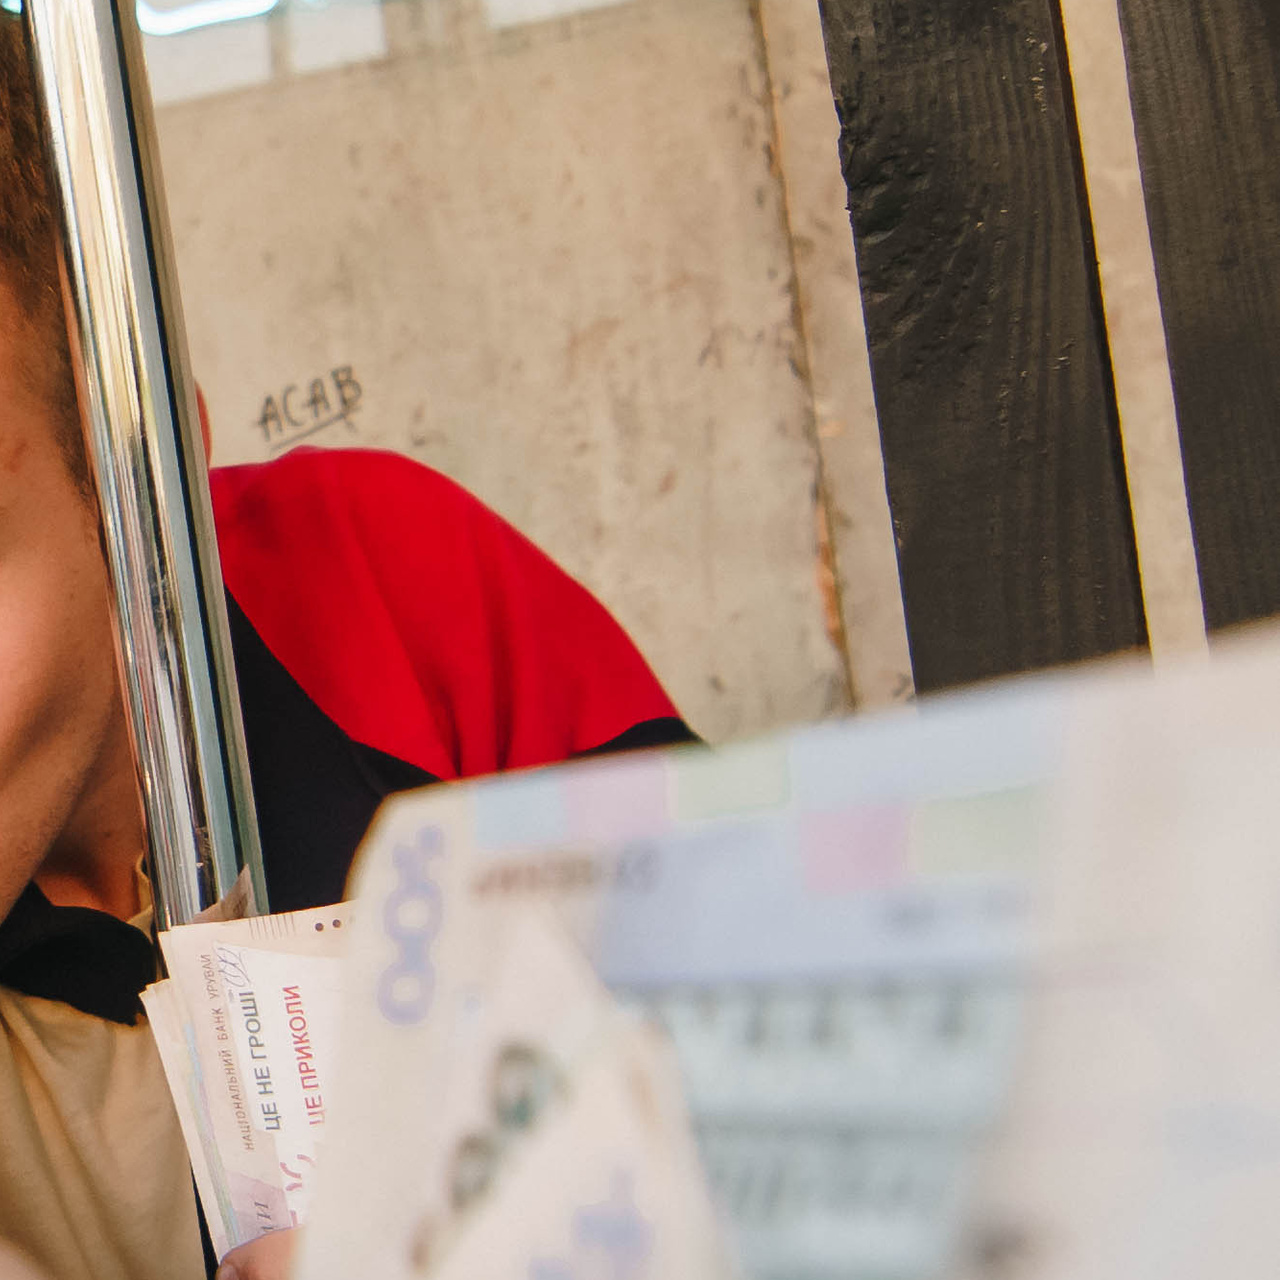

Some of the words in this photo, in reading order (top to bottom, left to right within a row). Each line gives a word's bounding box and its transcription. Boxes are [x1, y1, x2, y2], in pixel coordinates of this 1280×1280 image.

[257, 364, 362, 442] ACAB
[211, 1007, 229, 1041] БАНК
[239, 991, 268, 1060] ГРОШІ
[282, 985, 319, 1090] ПРИКОЛИ
[218, 1049, 255, 1151] НАЦІОНАЛЬНИЙ
[254, 1066, 274, 1096] НЕ
[261, 1101, 282, 1131] ЦЕ
[305, 1095, 326, 1125] ЦЕ
